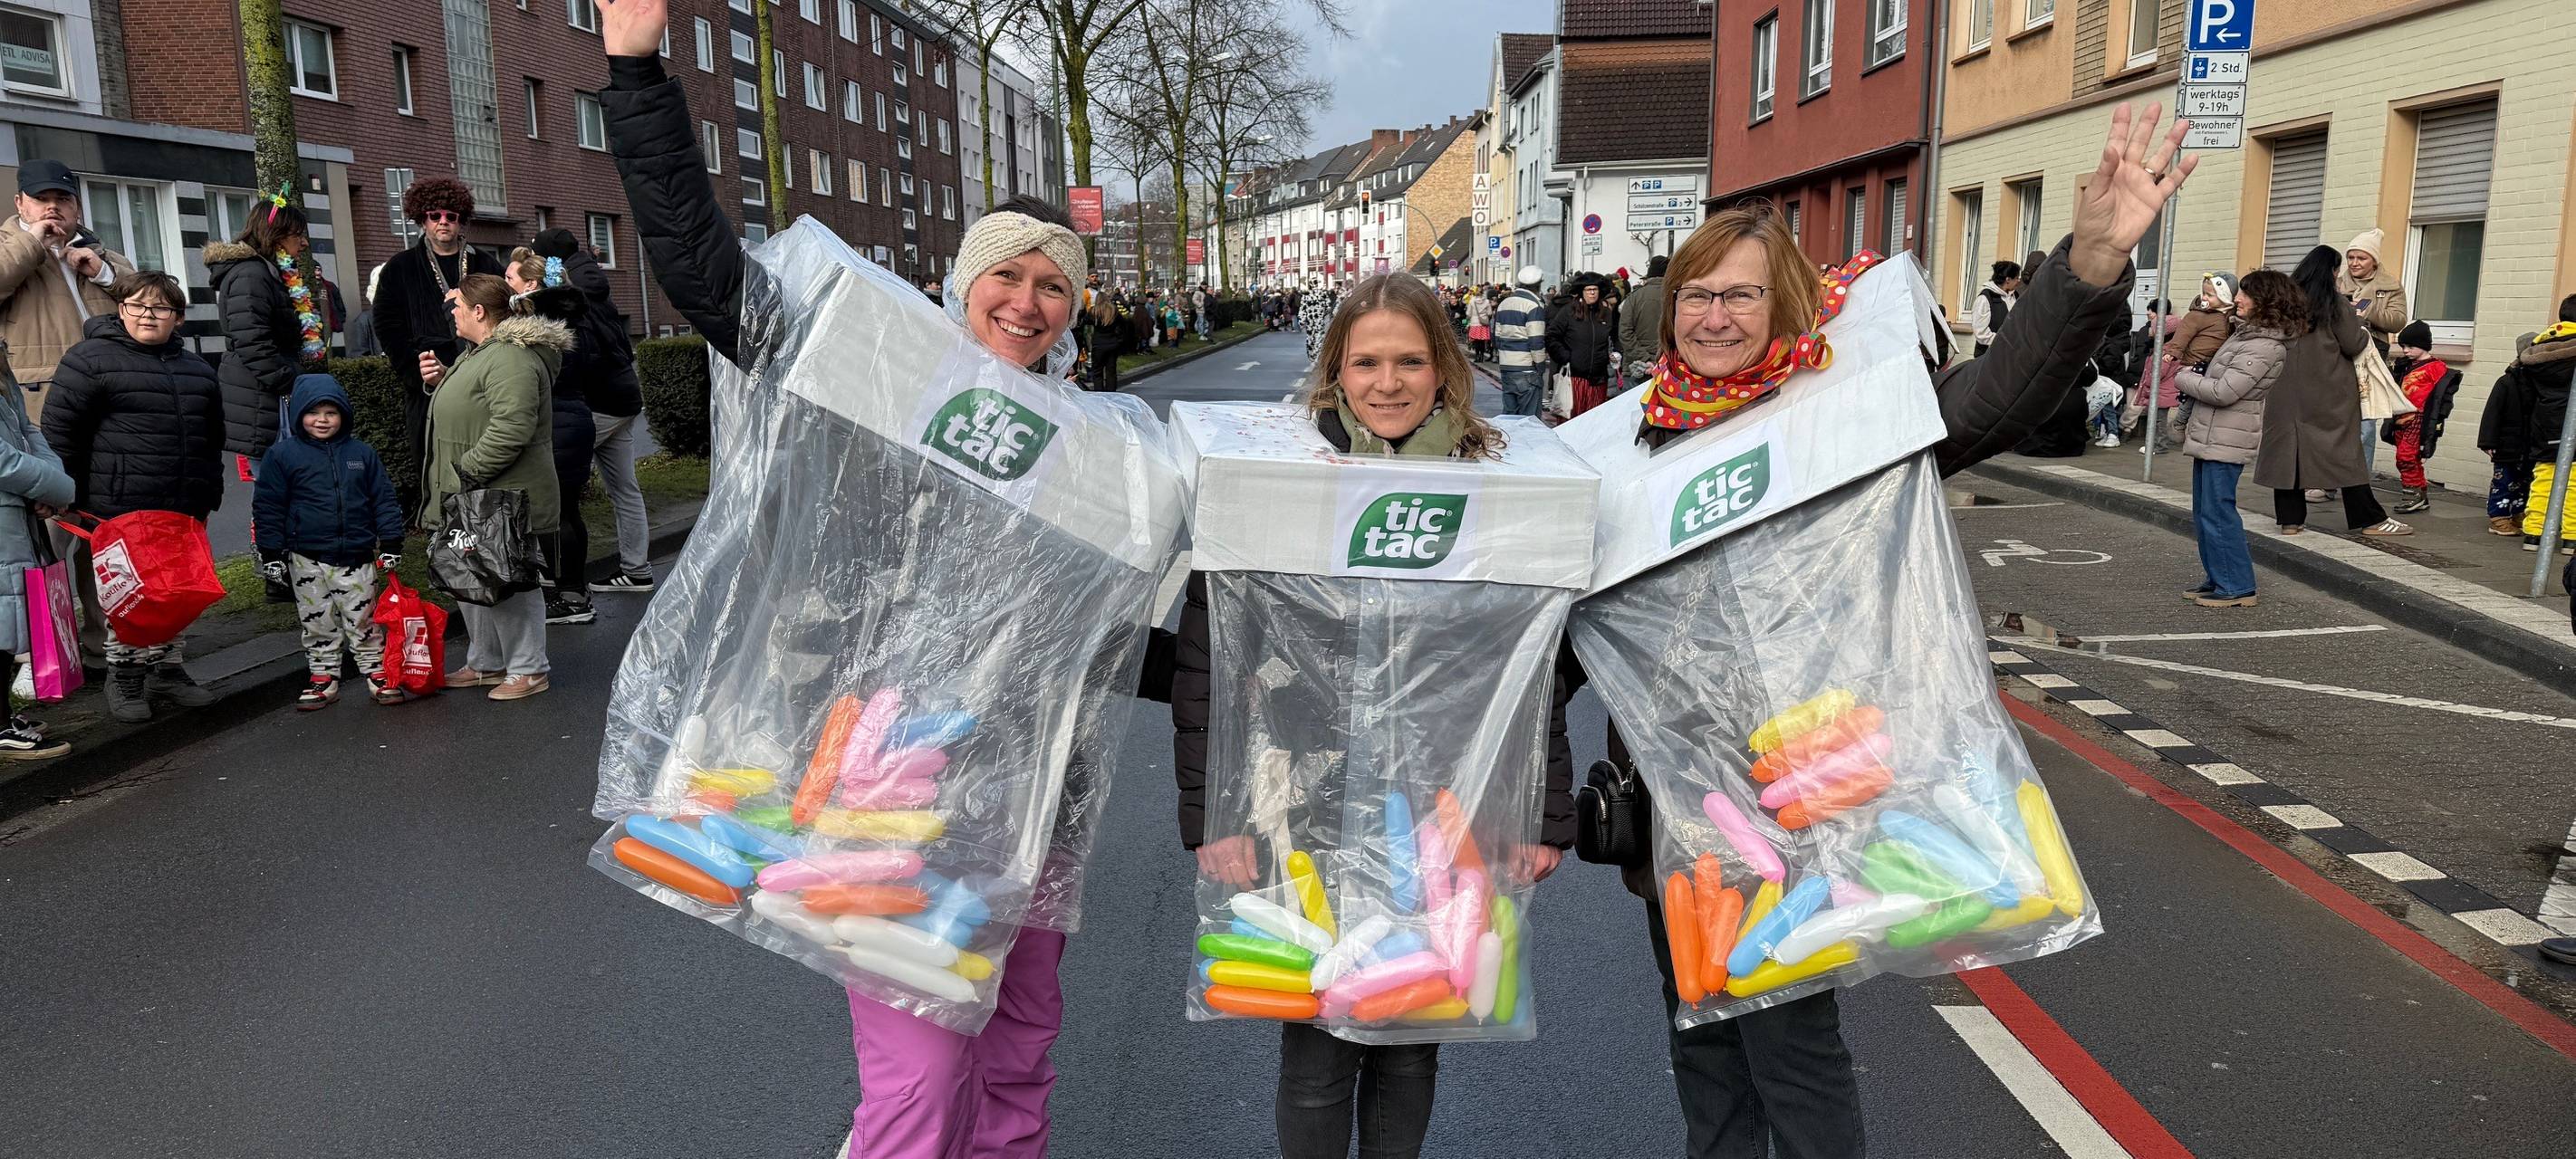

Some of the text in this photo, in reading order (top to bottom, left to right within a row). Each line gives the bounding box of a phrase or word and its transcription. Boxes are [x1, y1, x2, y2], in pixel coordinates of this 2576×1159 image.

[2, 46, 52, 64] ETL ADVISA
[2211, 62, 2243, 72] 2 Std.
[2190, 89, 2240, 101] werktags
[2198, 101, 2229, 112] 9-19h
[2188, 120, 2236, 129] Bewohner
[2203, 136, 2219, 145] frei
[1473, 176, 1487, 224] AWO
[972, 398, 1033, 451] tic
[942, 413, 1019, 474] tac
[1695, 463, 1753, 506] tic
[1385, 498, 1447, 532] tic
[1682, 484, 1754, 532] tac
[1364, 526, 1440, 560] tac
